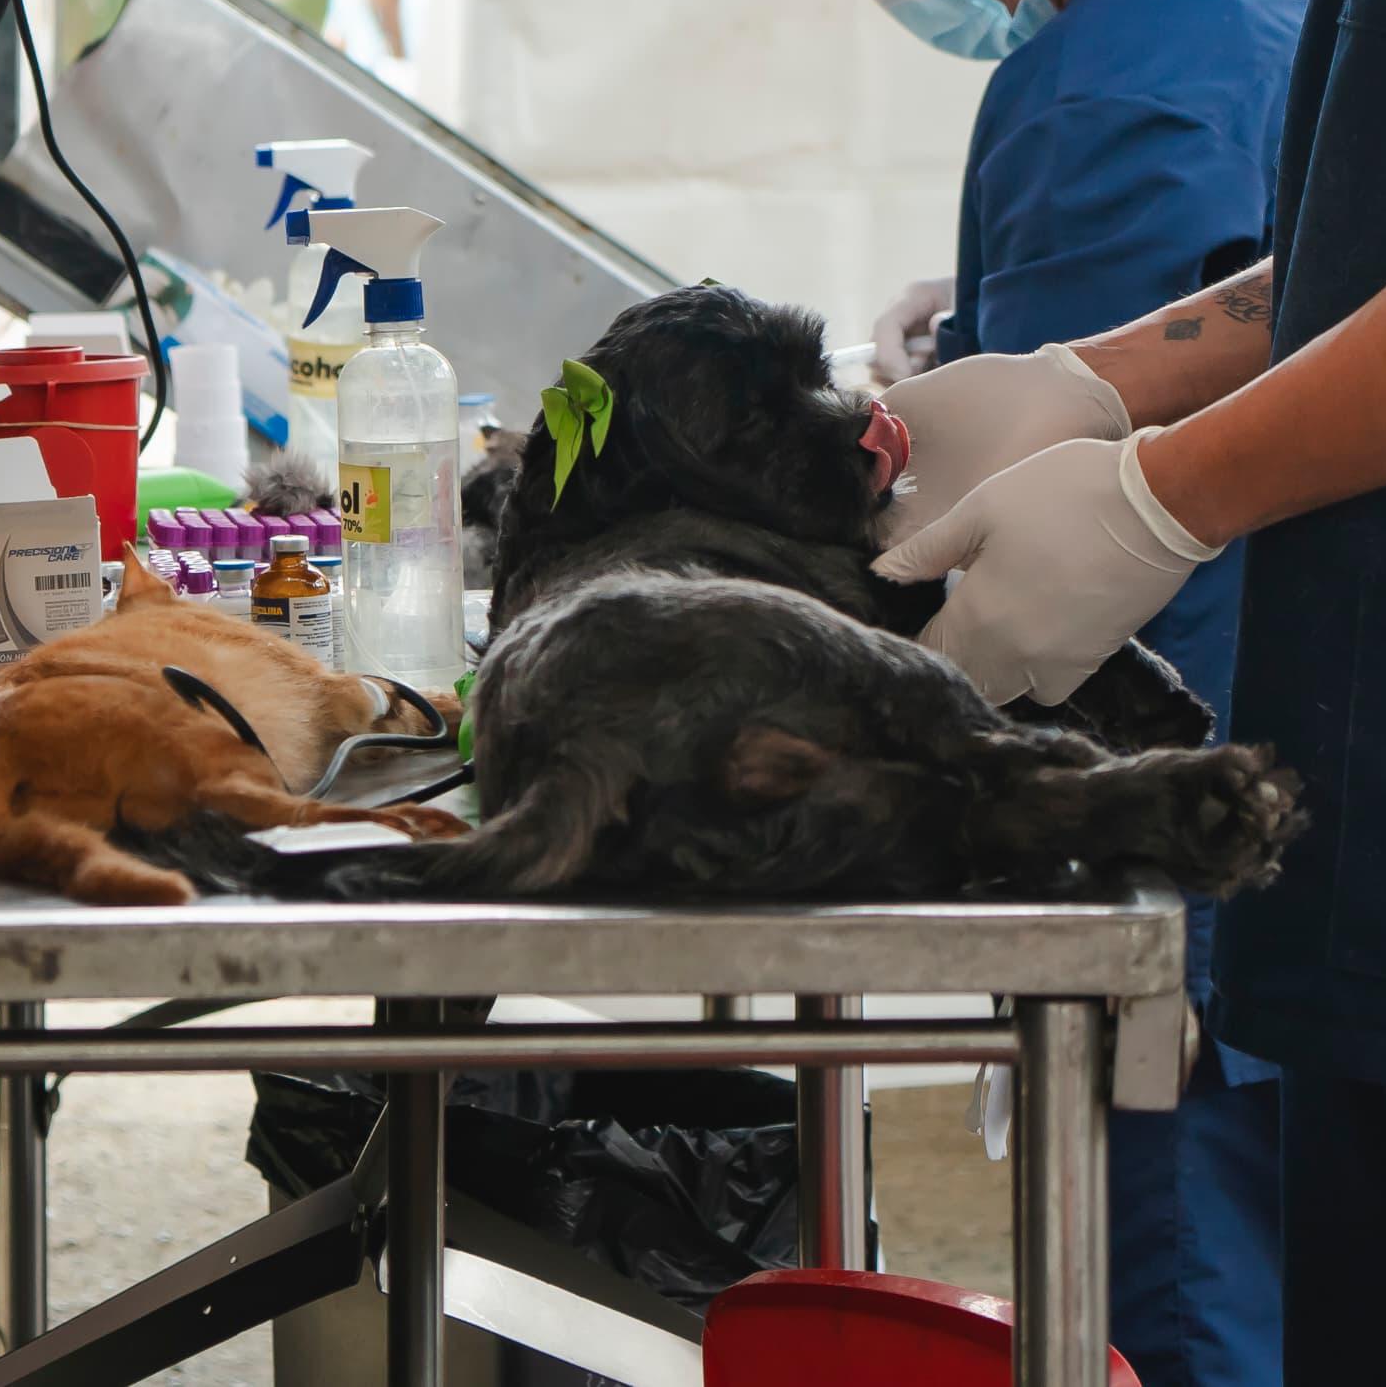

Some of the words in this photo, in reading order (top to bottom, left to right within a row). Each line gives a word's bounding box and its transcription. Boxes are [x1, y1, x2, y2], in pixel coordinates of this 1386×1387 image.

[340, 481, 360, 514] ol
[342, 518, 363, 533] 70%
[8, 545, 70, 558] PRECISION
[47, 553, 80, 563] CARE
